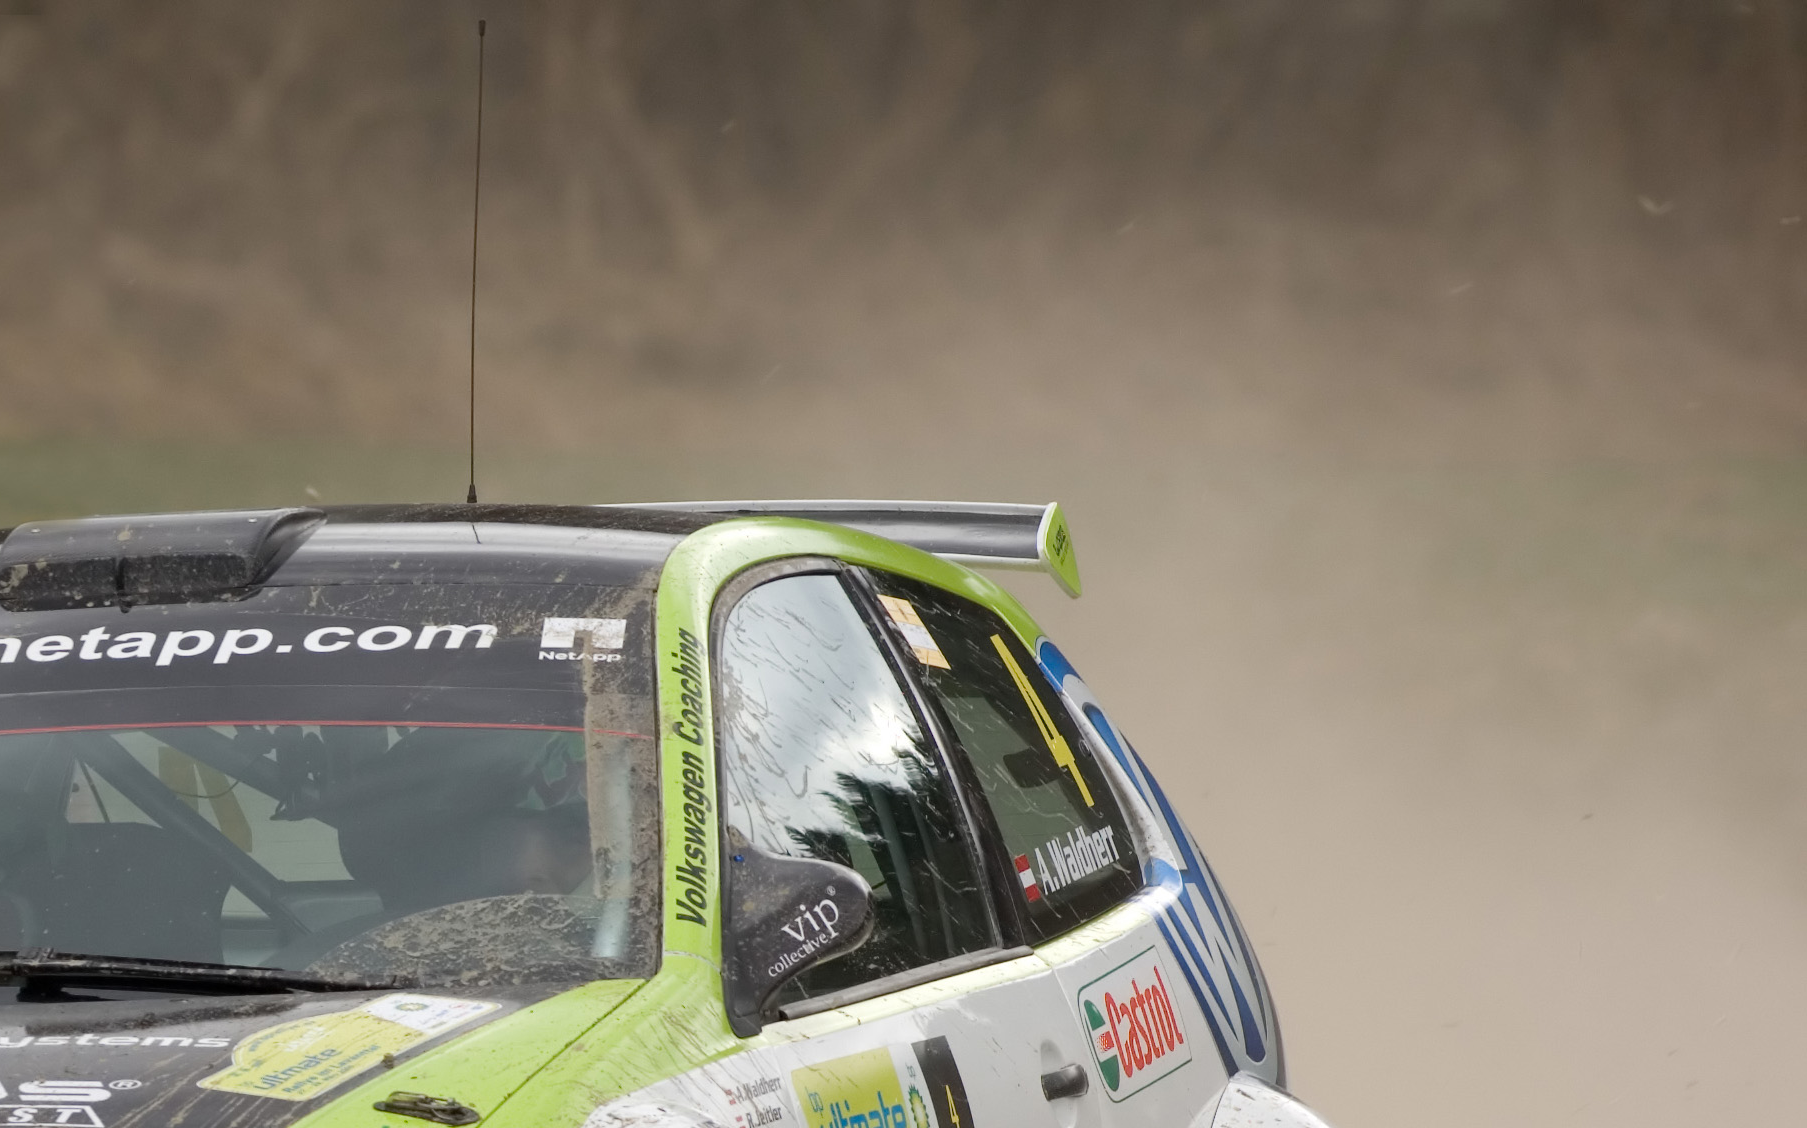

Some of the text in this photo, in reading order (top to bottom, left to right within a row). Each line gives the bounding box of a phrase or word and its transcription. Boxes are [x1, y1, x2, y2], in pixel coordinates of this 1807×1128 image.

[538, 650, 622, 663] NetApp
[989, 633, 1094, 807] 4
[671, 627, 713, 927] Volkswagen Coaching
[1033, 825, 1120, 896] A.Waldherr
[767, 932, 830, 978] collective
[781, 898, 840, 942] vip
[1104, 966, 1185, 1078] Castrol
